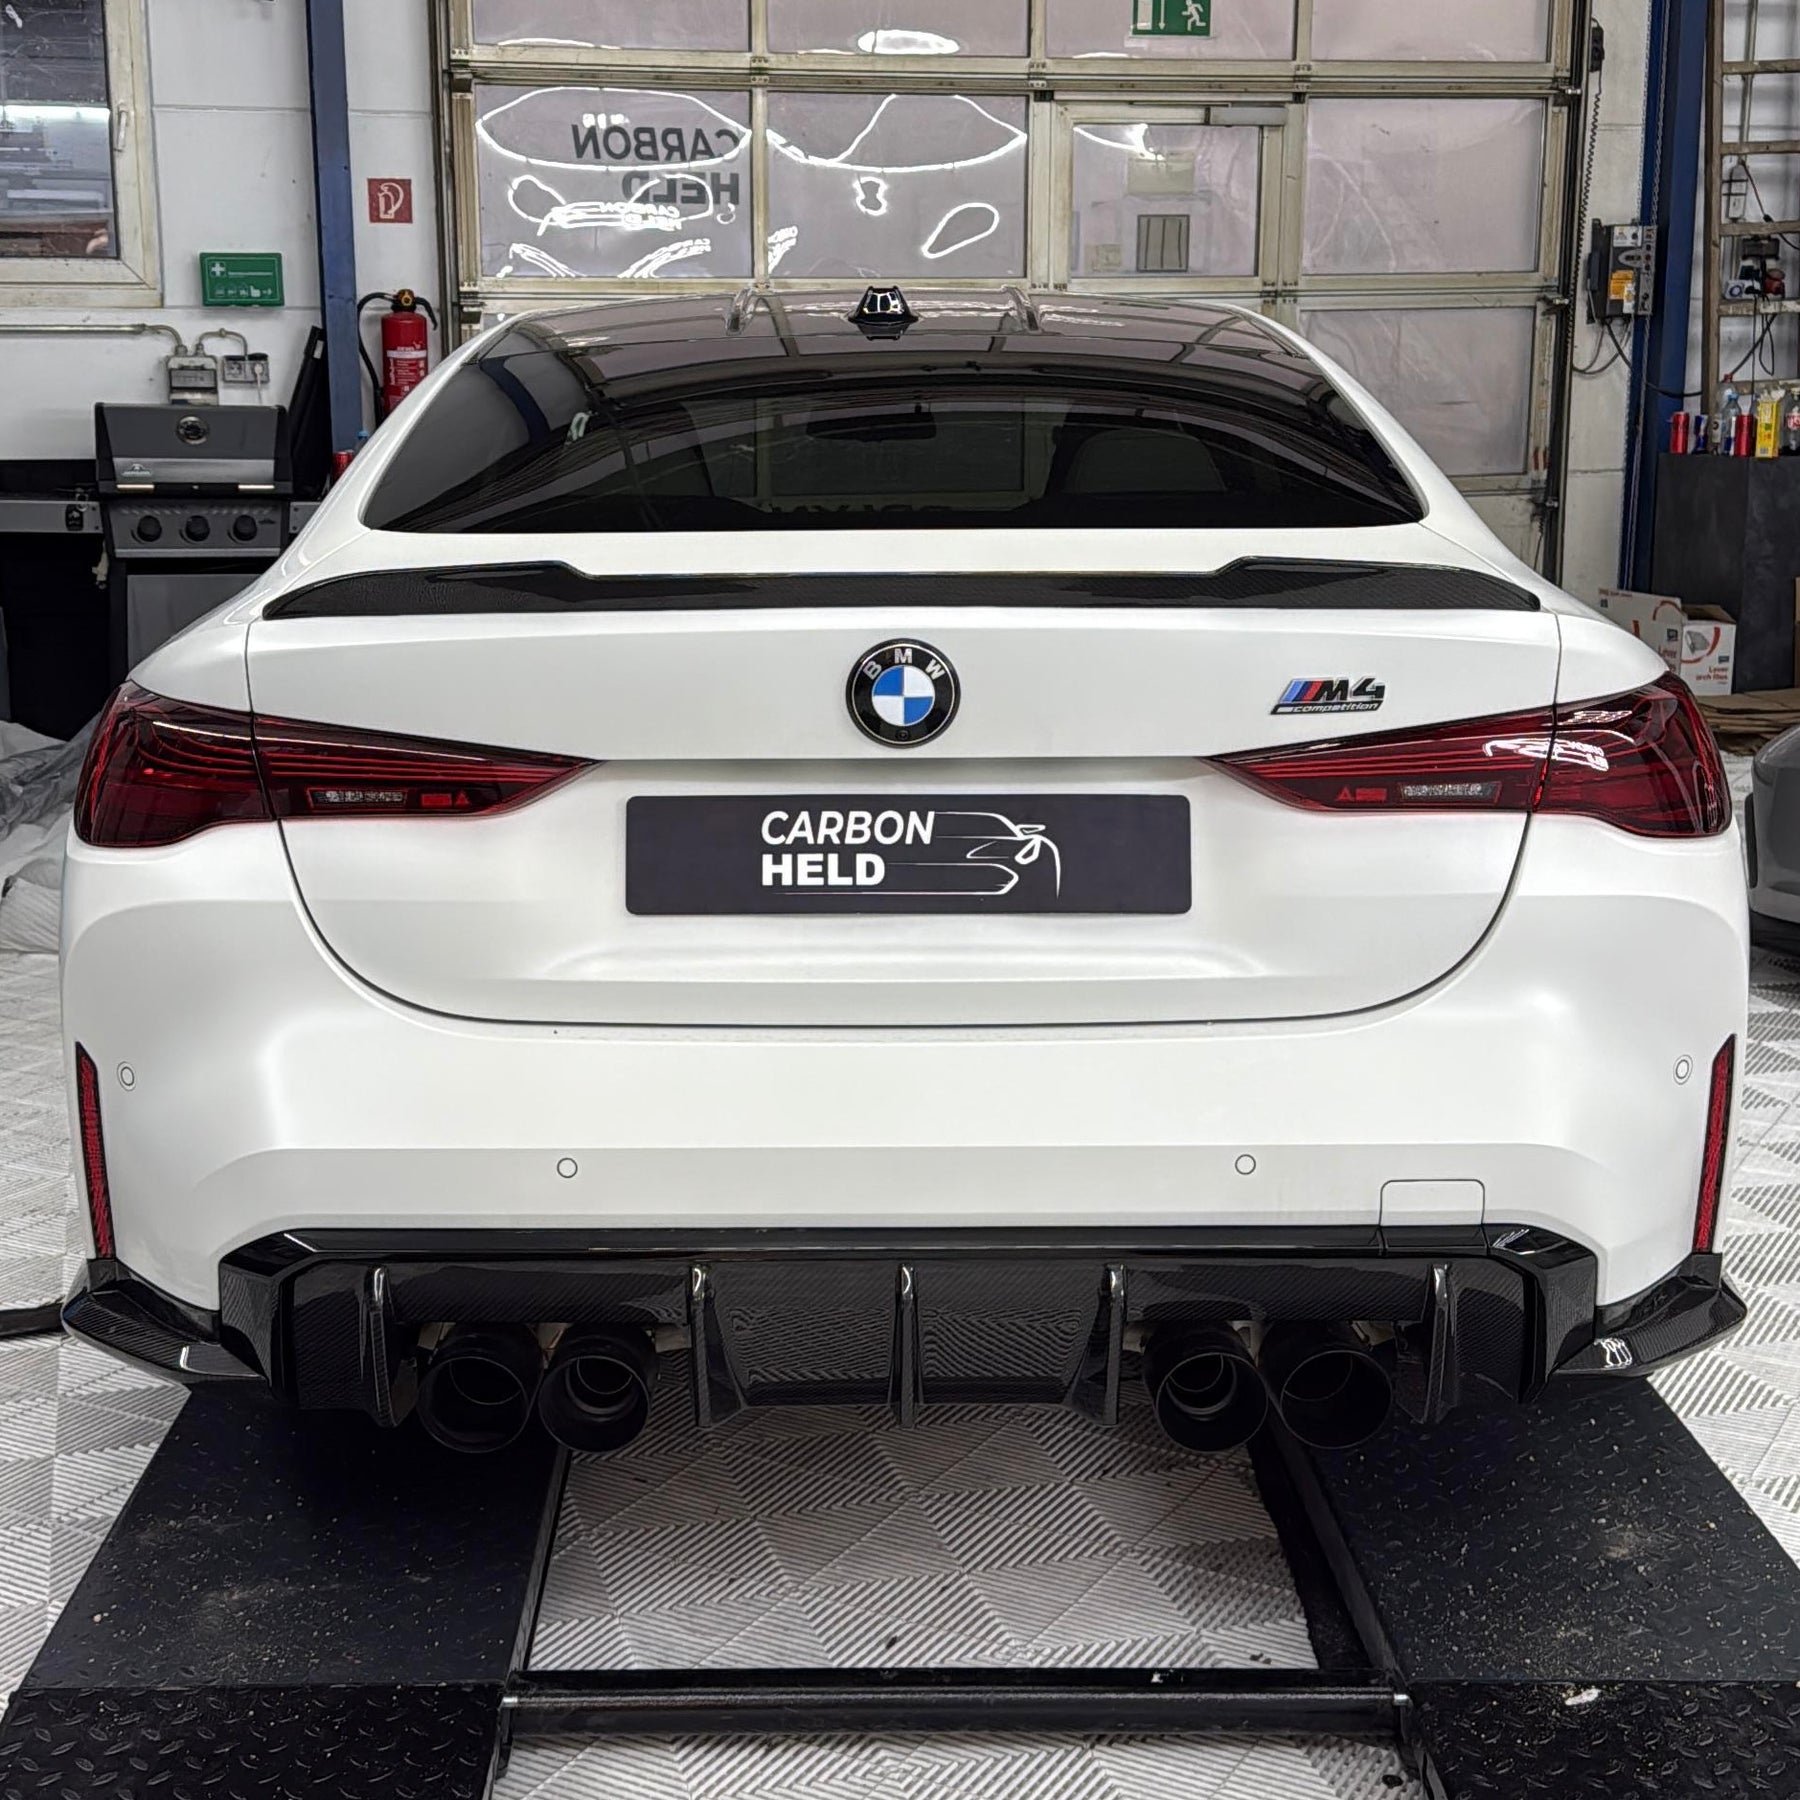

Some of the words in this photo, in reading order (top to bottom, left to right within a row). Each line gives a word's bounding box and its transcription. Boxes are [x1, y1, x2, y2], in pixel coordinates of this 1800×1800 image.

[863, 648, 945, 680] BMW
[1309, 677, 1385, 701] M4
[1293, 702, 1379, 713] competition
[761, 810, 935, 845] CARBON
[762, 853, 885, 886] HELD
